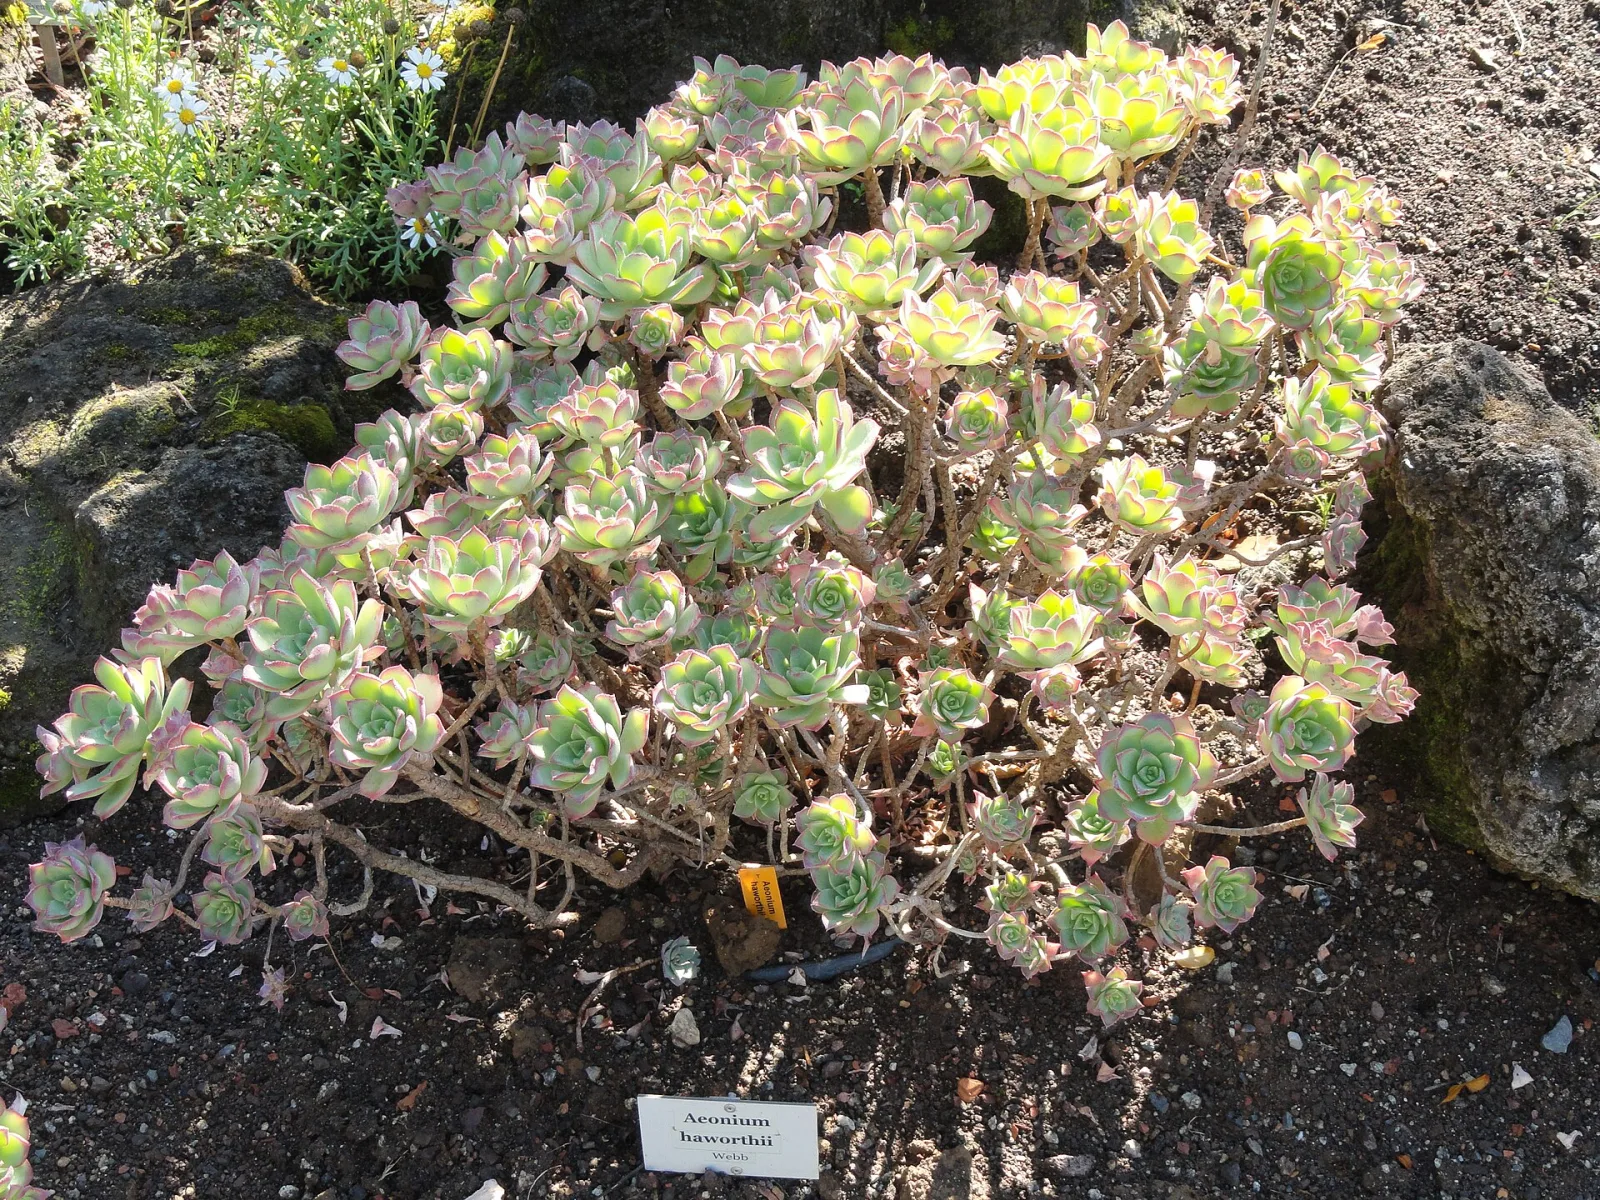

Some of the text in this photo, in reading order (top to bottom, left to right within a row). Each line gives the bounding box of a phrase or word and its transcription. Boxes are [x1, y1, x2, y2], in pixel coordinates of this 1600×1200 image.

[762, 880, 776, 915] Aeonium
[683, 1112, 771, 1127] Aeonium
[679, 1130, 774, 1147] haworthii
[712, 1152, 749, 1161] Webb
